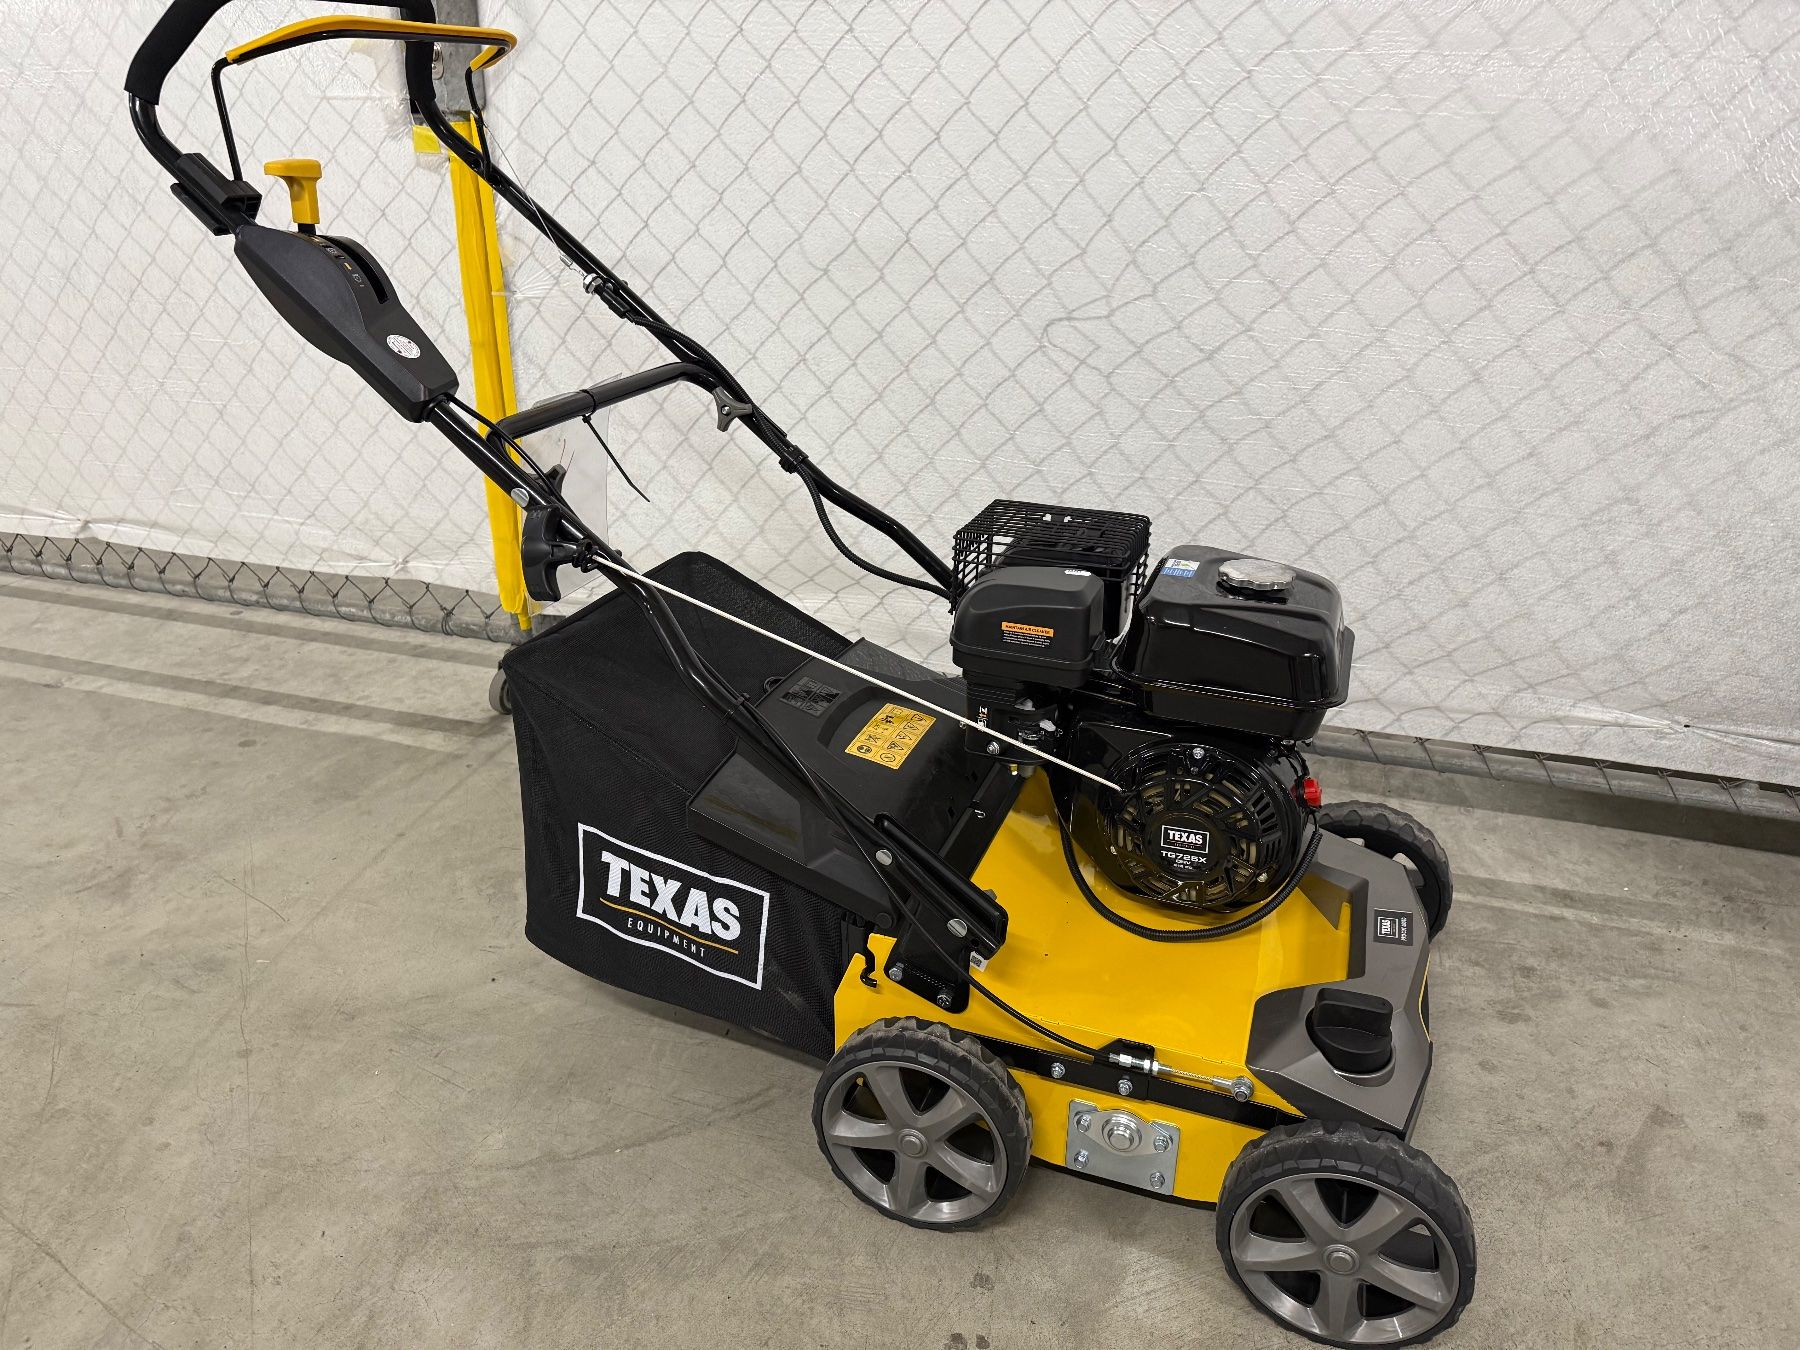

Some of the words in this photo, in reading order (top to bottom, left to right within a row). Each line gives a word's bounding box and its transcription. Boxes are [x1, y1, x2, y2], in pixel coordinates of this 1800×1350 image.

[1167, 830, 1203, 844] TEXAS
[600, 850, 741, 941] TEXAS
[627, 917, 706, 958] EQUIPMENT
